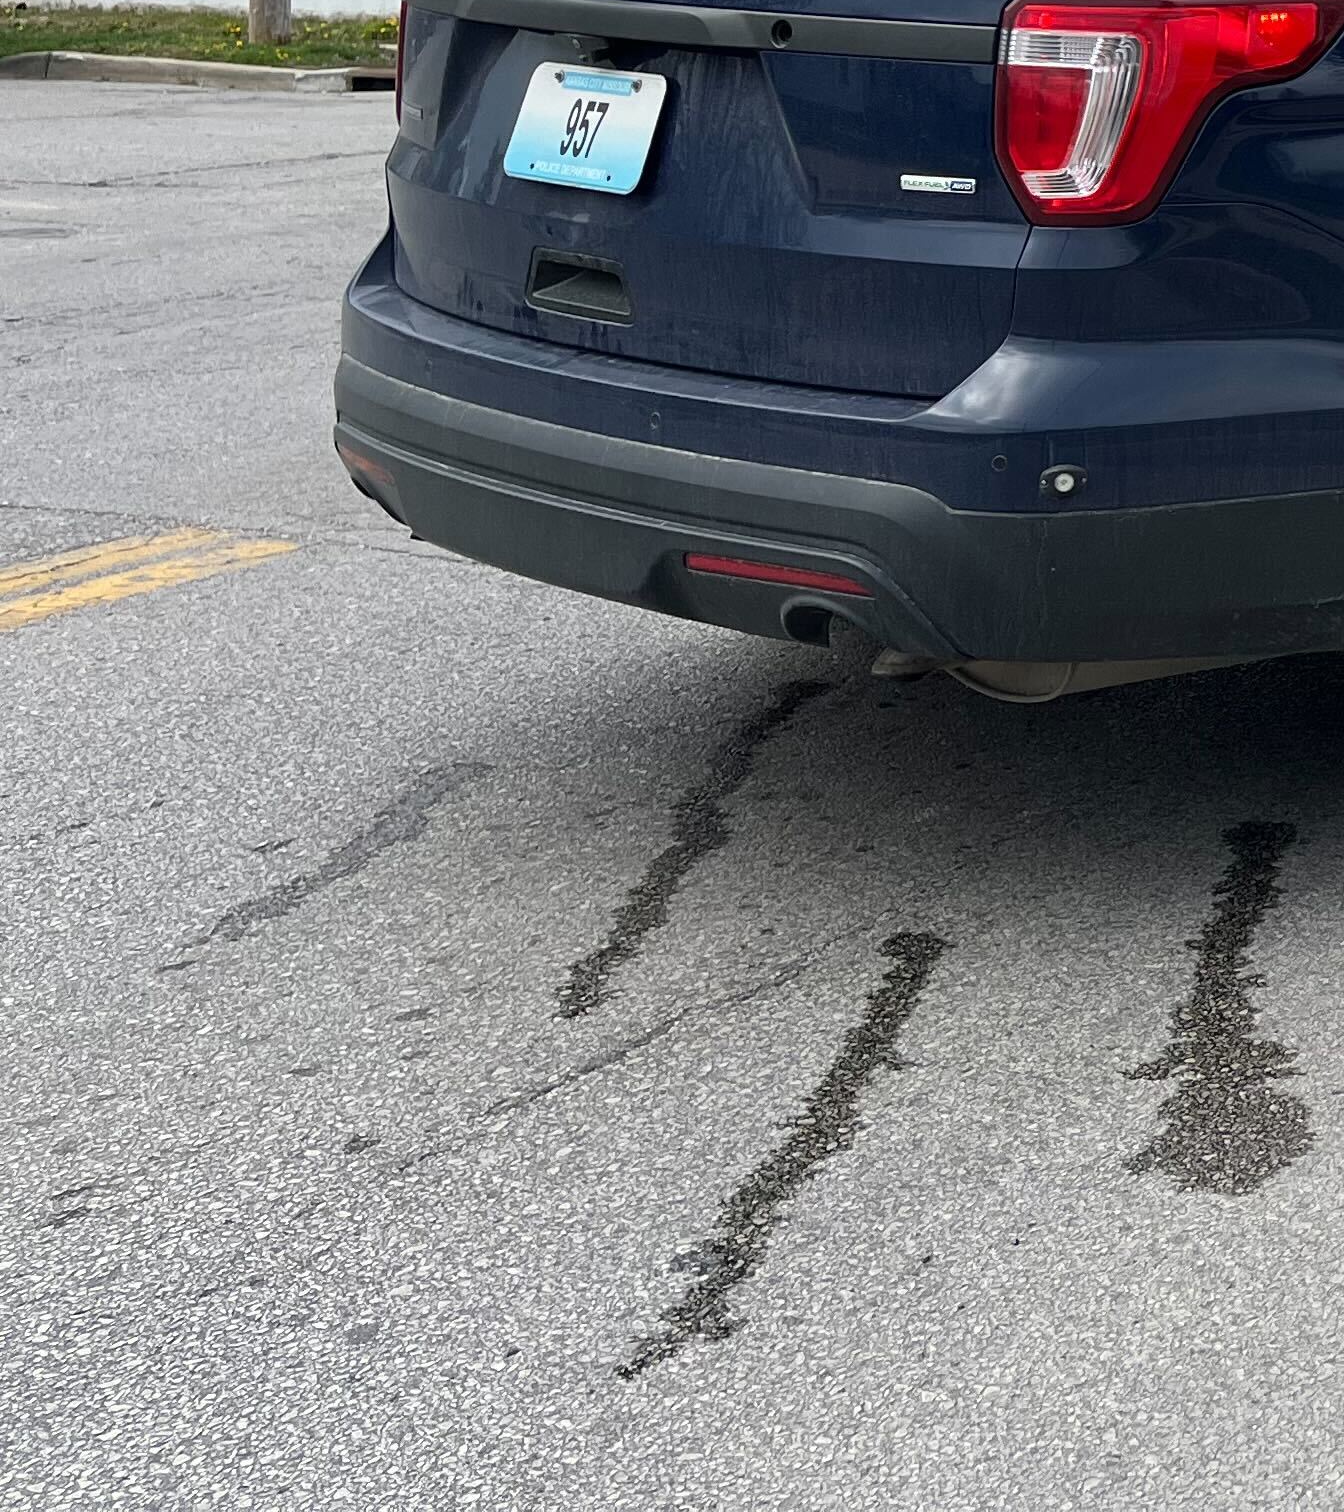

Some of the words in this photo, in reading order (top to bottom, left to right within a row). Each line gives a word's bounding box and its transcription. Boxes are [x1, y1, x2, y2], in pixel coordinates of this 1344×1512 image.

[559, 98, 610, 159] 957
[535, 160, 560, 174] POLICE
[560, 163, 607, 180] DEPARTMENT
